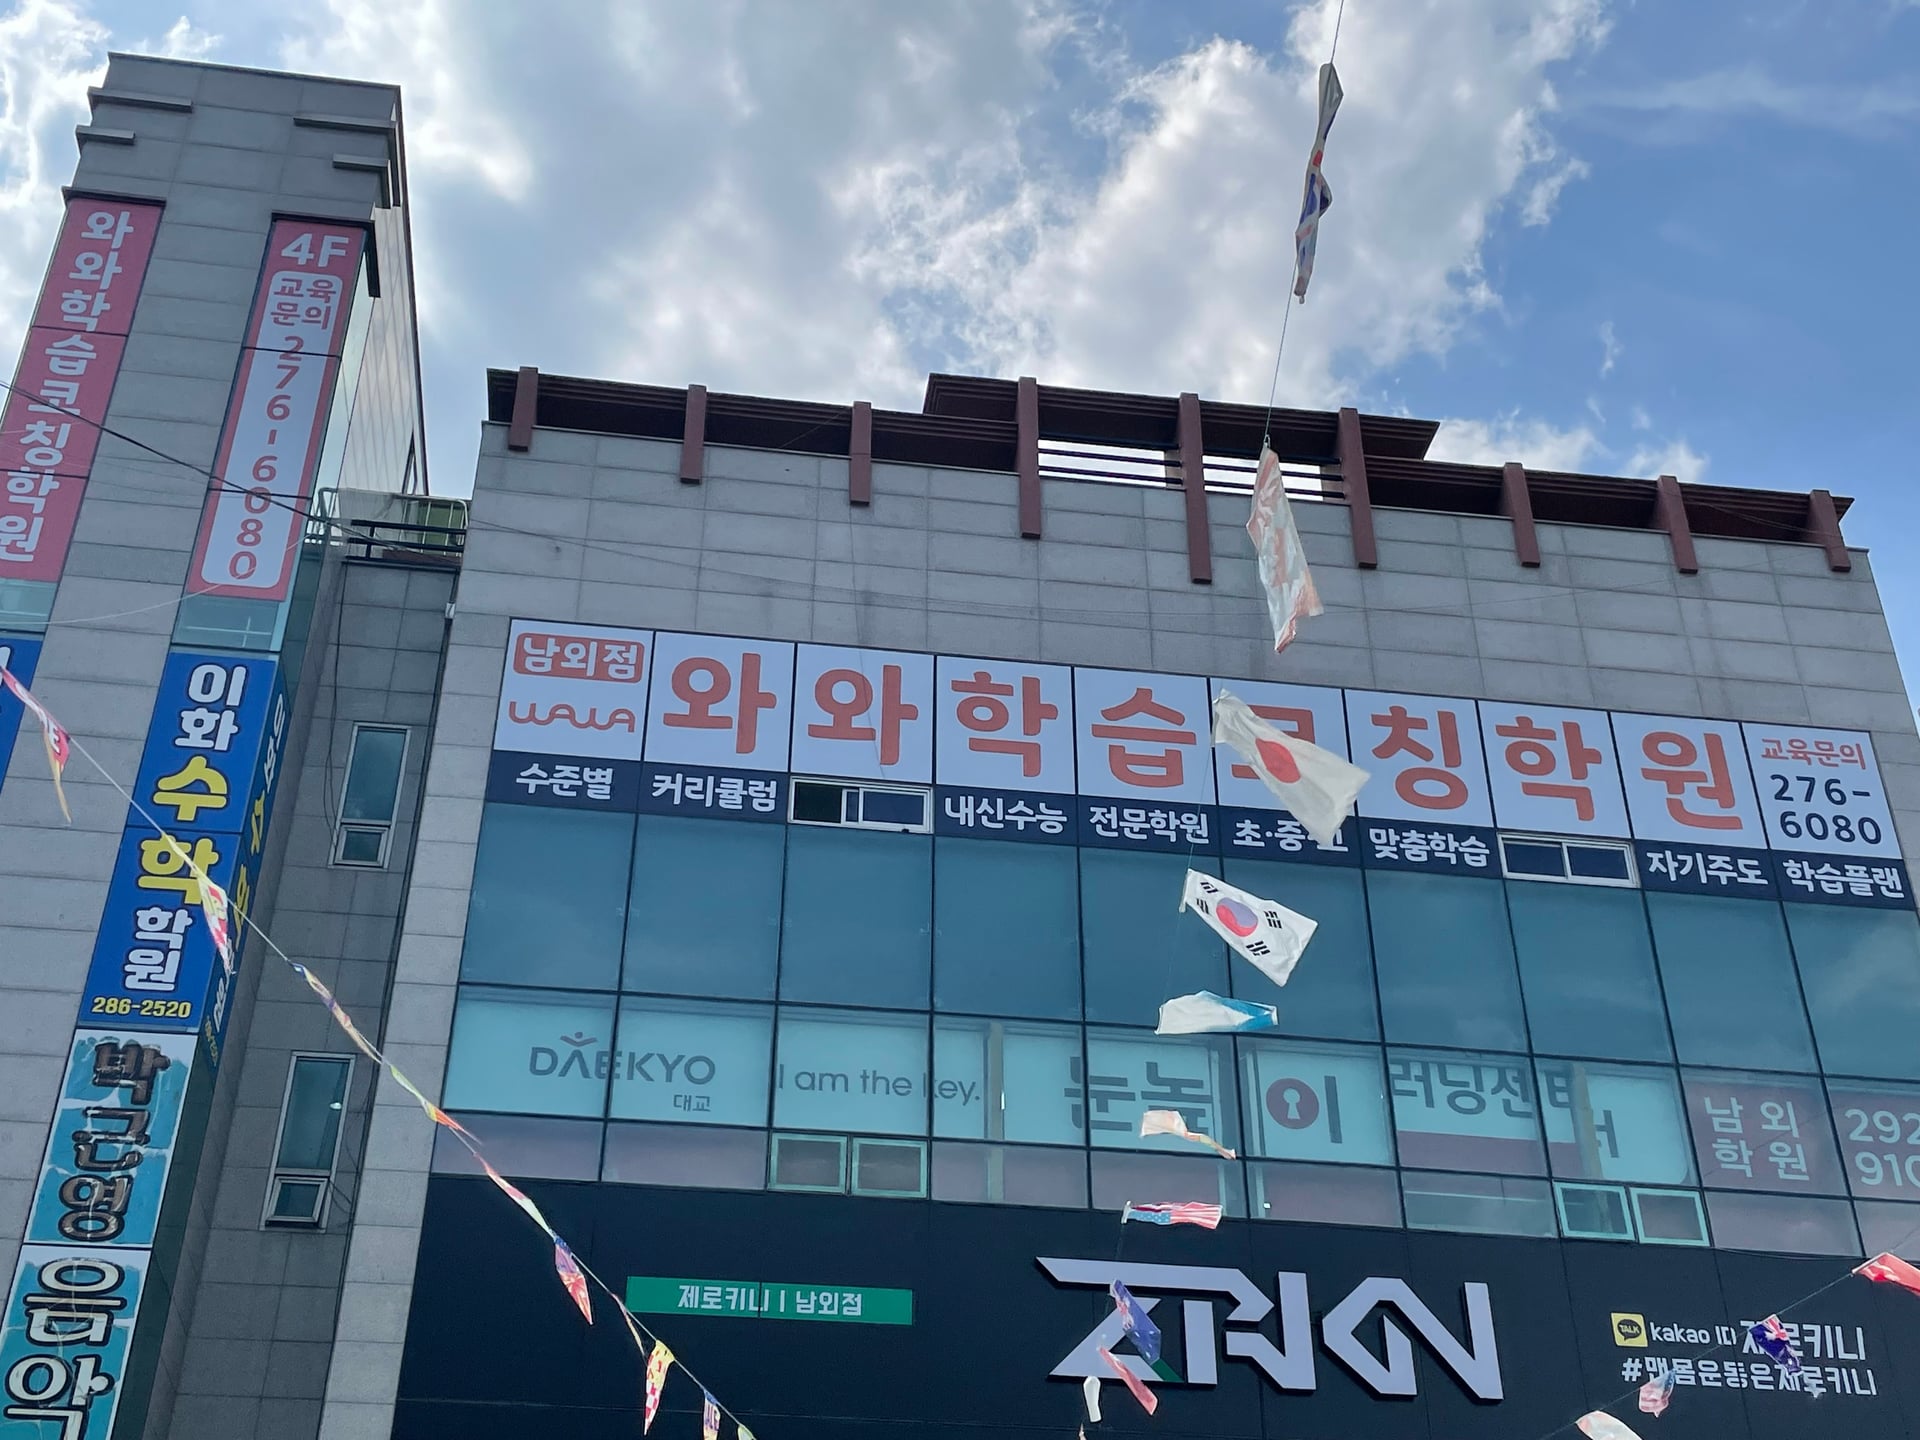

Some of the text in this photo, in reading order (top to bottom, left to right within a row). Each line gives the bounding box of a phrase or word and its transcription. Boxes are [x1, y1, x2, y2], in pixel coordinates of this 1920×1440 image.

[281, 233, 349, 267] 4F
[274, 278, 336, 303] 교육
[271, 302, 331, 329] 문의
[229, 336, 304, 580] 276-6080
[523, 637, 637, 680] 남외점
[1761, 738, 1866, 770] 교육문의
[516, 763, 614, 800] 수준별
[652, 773, 777, 812] 커리큘럼
[944, 795, 1067, 834] 내신수능
[1089, 806, 1209, 845] 전문학원
[1368, 828, 1490, 867] 맞춤학습
[1647, 850, 1769, 886] 자기주도
[1783, 859, 1905, 899] 학습플랜
[1780, 811, 1882, 845] 6080
[92, 996, 191, 1018] 286-2520
[529, 1046, 715, 1085] DAEKYO
[795, 1070, 849, 1093] am
[860, 1069, 912, 1096] the
[673, 1093, 711, 1112] 대교
[1713, 1138, 1810, 1181] 학원
[677, 1284, 862, 1316] 제로키니 남외점
[1649, 1322, 1711, 1344] kakao
